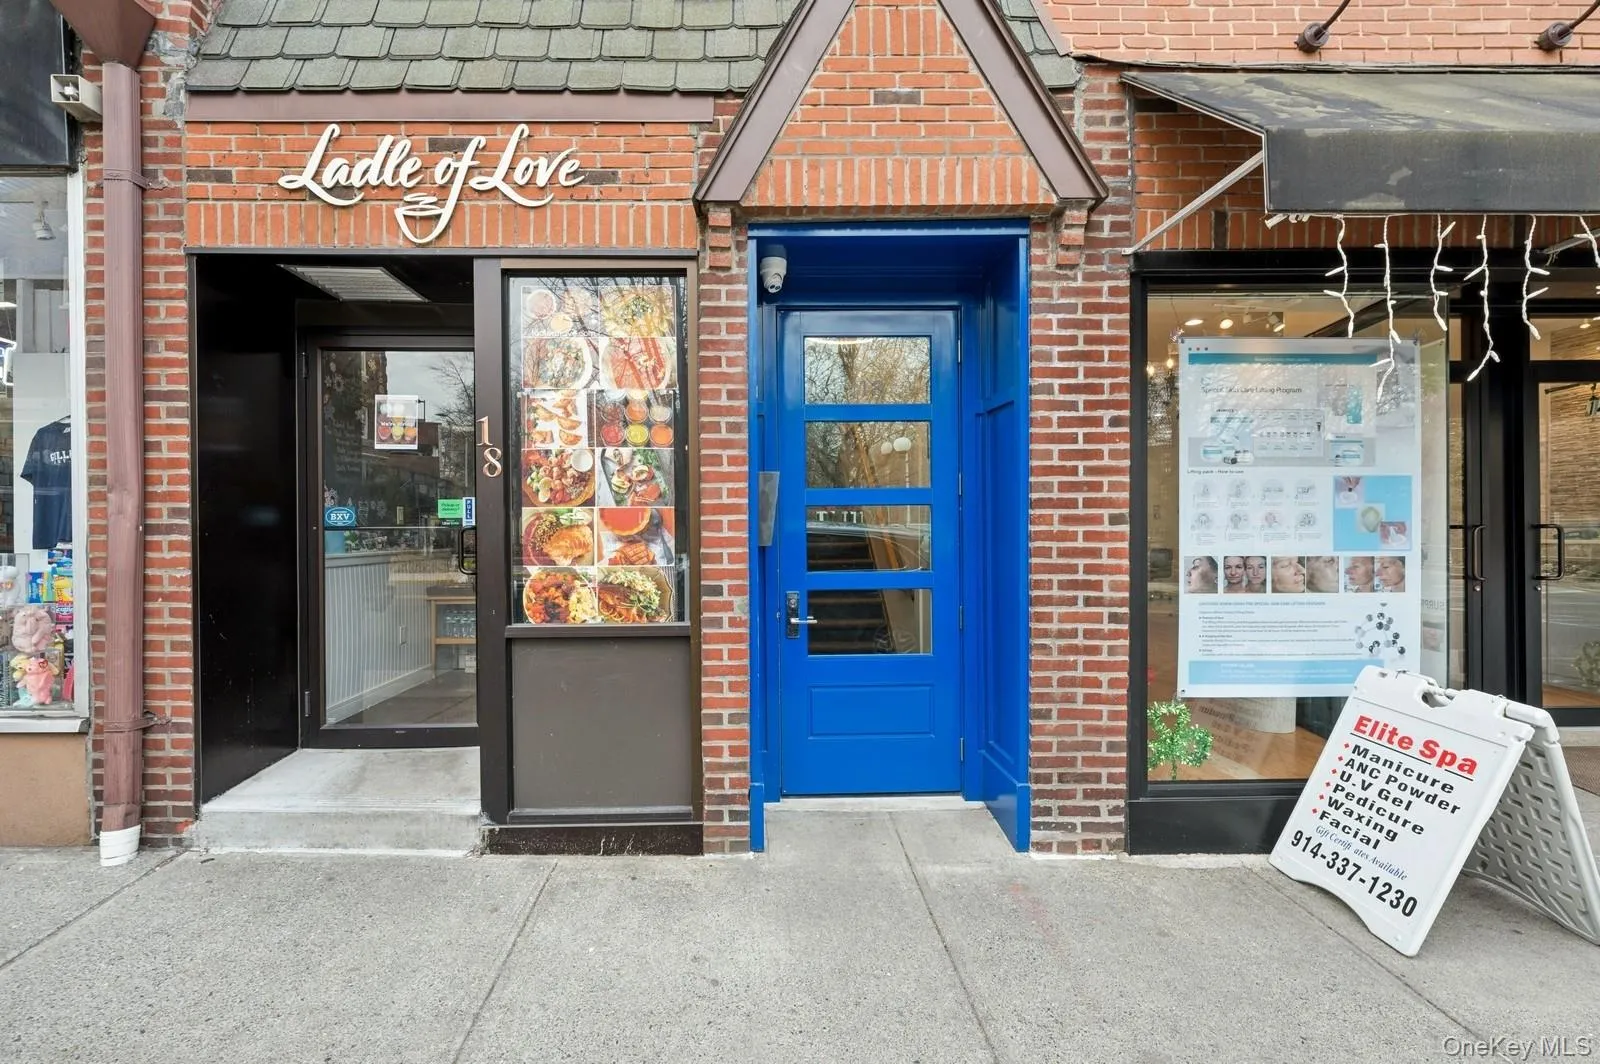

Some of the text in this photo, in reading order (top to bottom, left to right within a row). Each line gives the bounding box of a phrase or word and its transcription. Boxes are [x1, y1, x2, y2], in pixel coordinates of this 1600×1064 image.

[278, 123, 424, 206] Ladle
[469, 123, 585, 207] Love
[1276, 386, 1303, 396] Program
[330, 513, 350, 521] BXV
[1351, 744, 1454, 794] Manicure
[1353, 714, 1478, 775] Elite Spa
[1332, 783, 1425, 835] Pedicure
[1339, 770, 1413, 812] U-V Gel
[1344, 758, 1461, 814] ANC Powder
[1319, 810, 1381, 850] Facial
[1327, 796, 1398, 842] Waxing
[1291, 829, 1418, 918] 914-337-1230
[1315, 825, 1408, 881] Gift Certifiates Available
